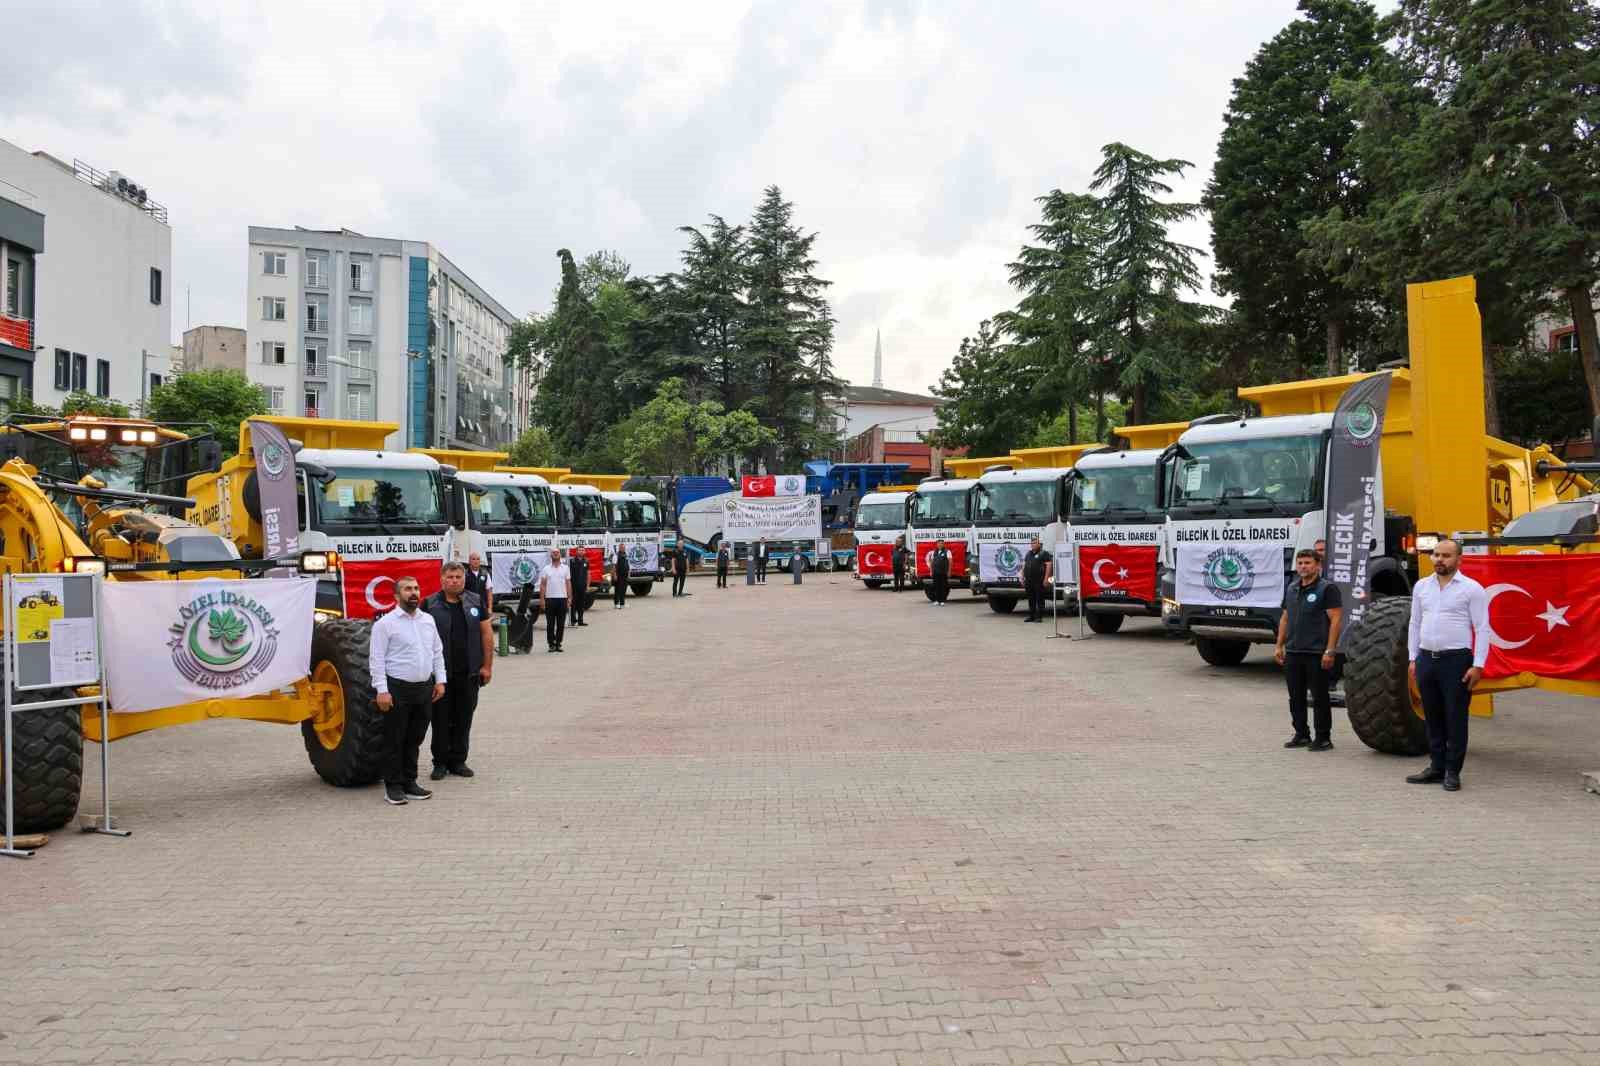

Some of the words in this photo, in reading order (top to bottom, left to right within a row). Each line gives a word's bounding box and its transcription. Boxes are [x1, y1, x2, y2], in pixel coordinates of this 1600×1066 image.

[1074, 530, 1099, 541] BİLECİK
[1100, 530, 1107, 540] İL
[1108, 530, 1127, 541] ÖZEL
[1128, 530, 1157, 541] İDARESİ
[1176, 527, 1209, 541] BİLECİK
[1211, 527, 1220, 541] İL
[1222, 525, 1246, 541] ÖZEL
[1249, 525, 1290, 540] İDARESİ
[337, 541, 374, 554] BİLECİK
[375, 541, 384, 554] İL
[386, 540, 408, 554] ÖZEL
[409, 539, 440, 553] İDARESİ
[487, 538, 511, 547] BİLECİK
[519, 537, 532, 547] ÖZEL
[1329, 511, 1355, 583] BİLECİK
[168, 621, 188, 635] İL
[178, 592, 218, 620] ÖZEL
[220, 588, 276, 626] İDARESİ
[196, 667, 259, 690] BİLECİK
